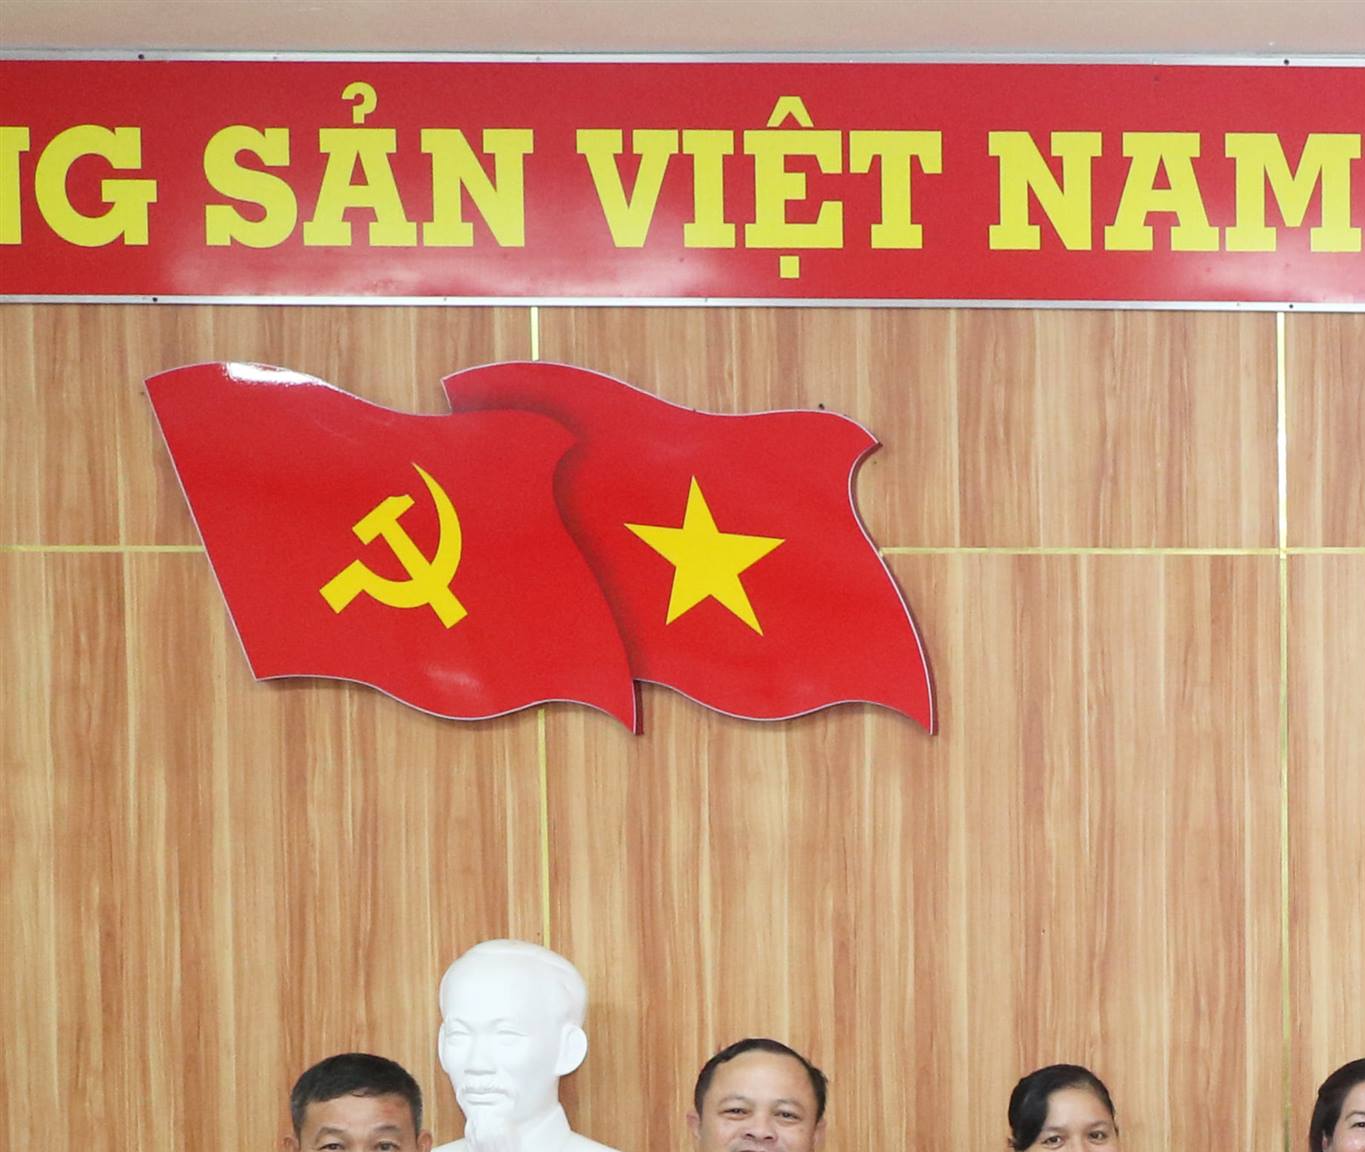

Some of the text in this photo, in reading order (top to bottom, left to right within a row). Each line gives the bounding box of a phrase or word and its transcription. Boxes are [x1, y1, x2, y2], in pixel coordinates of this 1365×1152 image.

[0, 125, 157, 247] G
[203, 82, 533, 249] SẢN
[576, 96, 942, 279] VIỆT
[988, 131, 1364, 255] NAM
